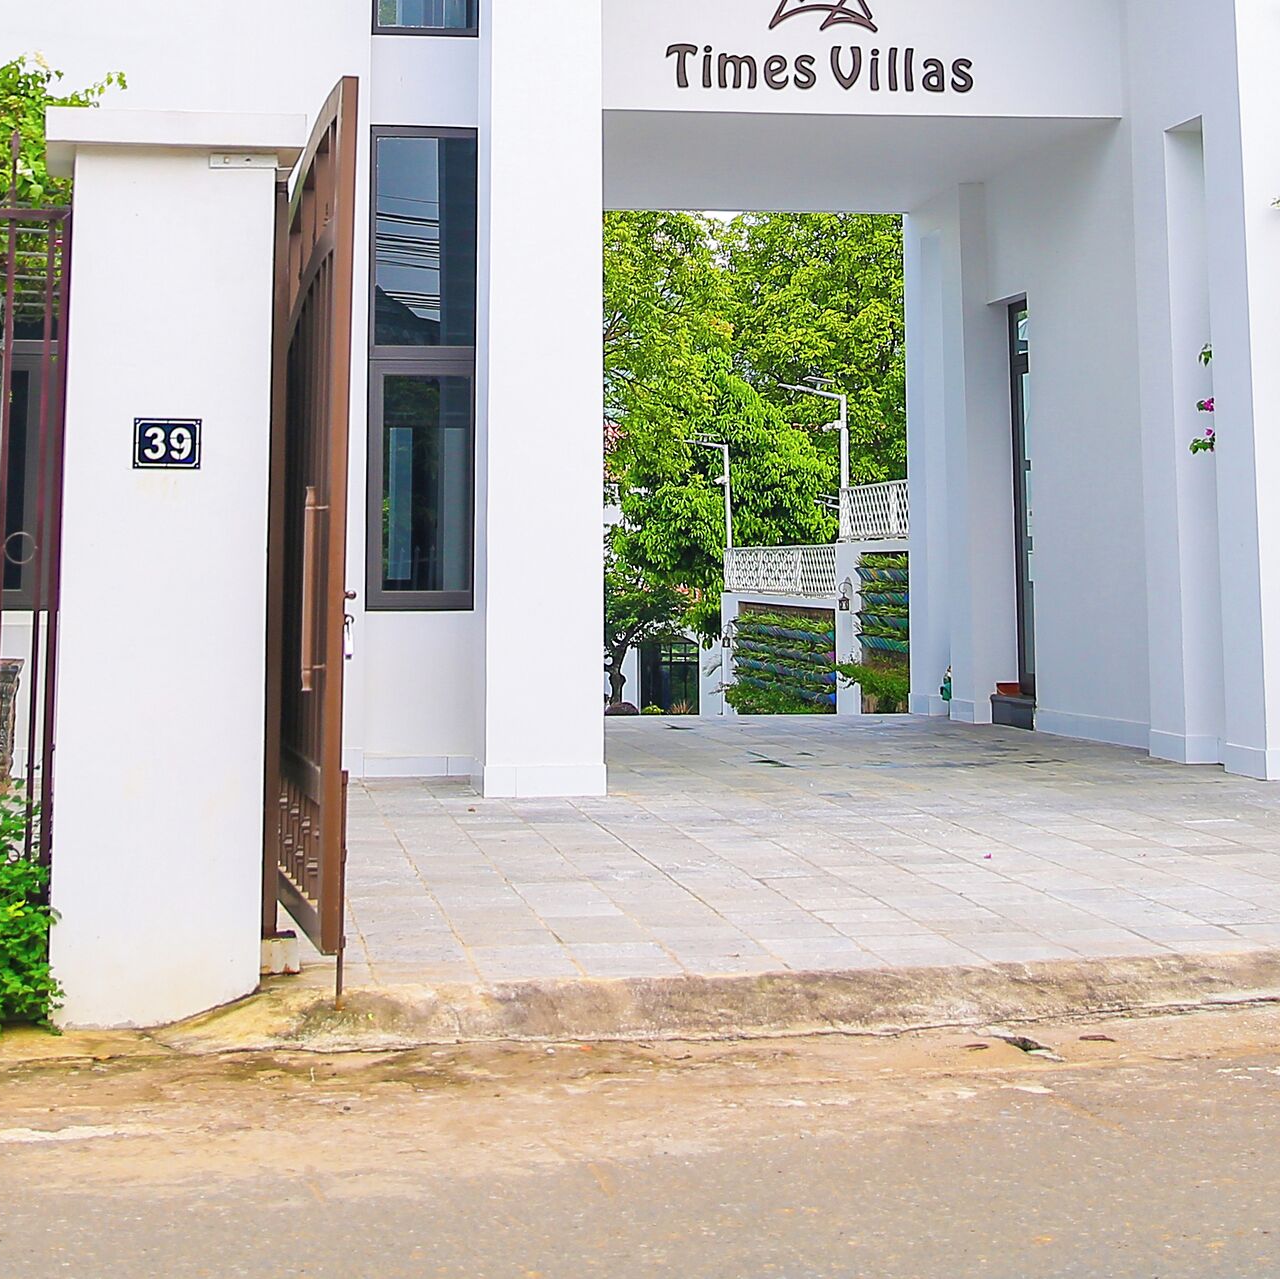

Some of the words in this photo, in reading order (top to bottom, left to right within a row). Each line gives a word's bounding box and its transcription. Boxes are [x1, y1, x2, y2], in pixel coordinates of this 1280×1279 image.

[666, 43, 817, 90] Times
[830, 45, 975, 93] Villas
[143, 426, 192, 461] 39
